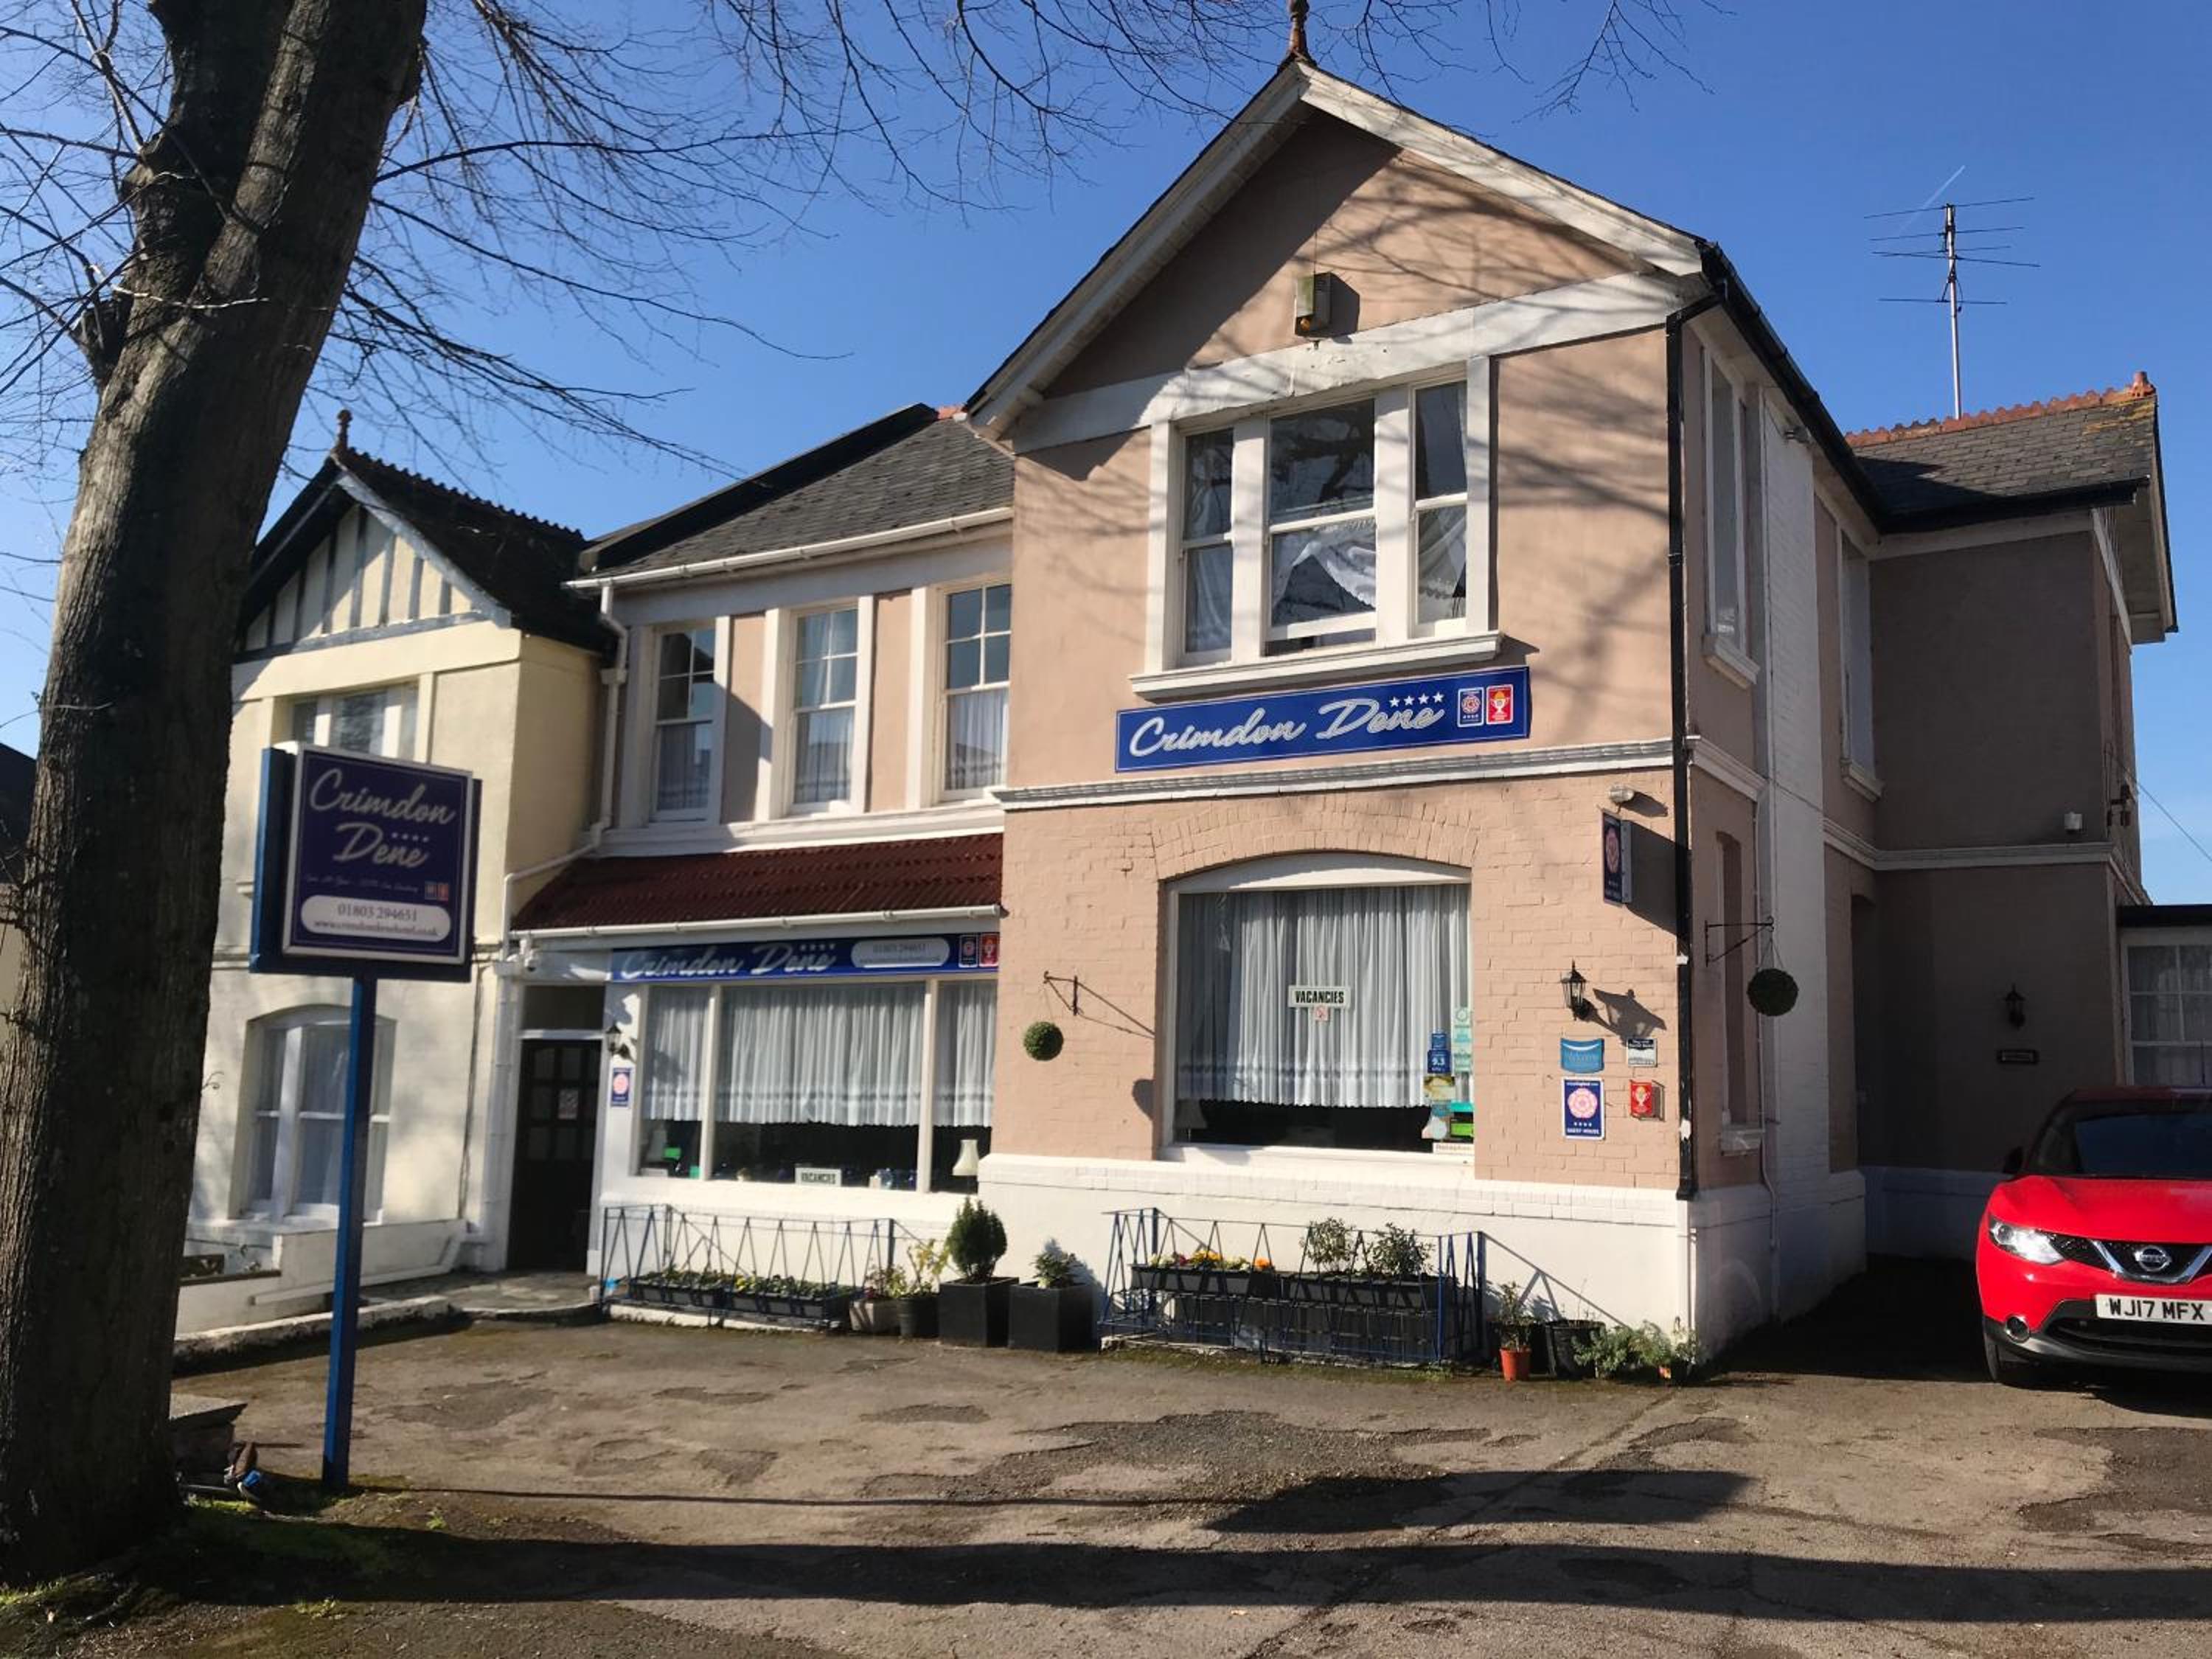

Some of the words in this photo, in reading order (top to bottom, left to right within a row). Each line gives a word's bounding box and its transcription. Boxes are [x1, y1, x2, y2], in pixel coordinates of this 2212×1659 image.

[1129, 707, 1307, 757] Crimdon
[1316, 698, 1444, 739] Dene
[309, 768, 456, 824] Crimdon
[333, 821, 429, 868] Dene
[620, 945, 744, 979] Crimdon
[751, 942, 837, 975] Dene
[1295, 990, 1345, 1004] VACANCIES
[2109, 1298, 2154, 1318] WJ17
[2162, 1301, 2205, 1321] MFX
